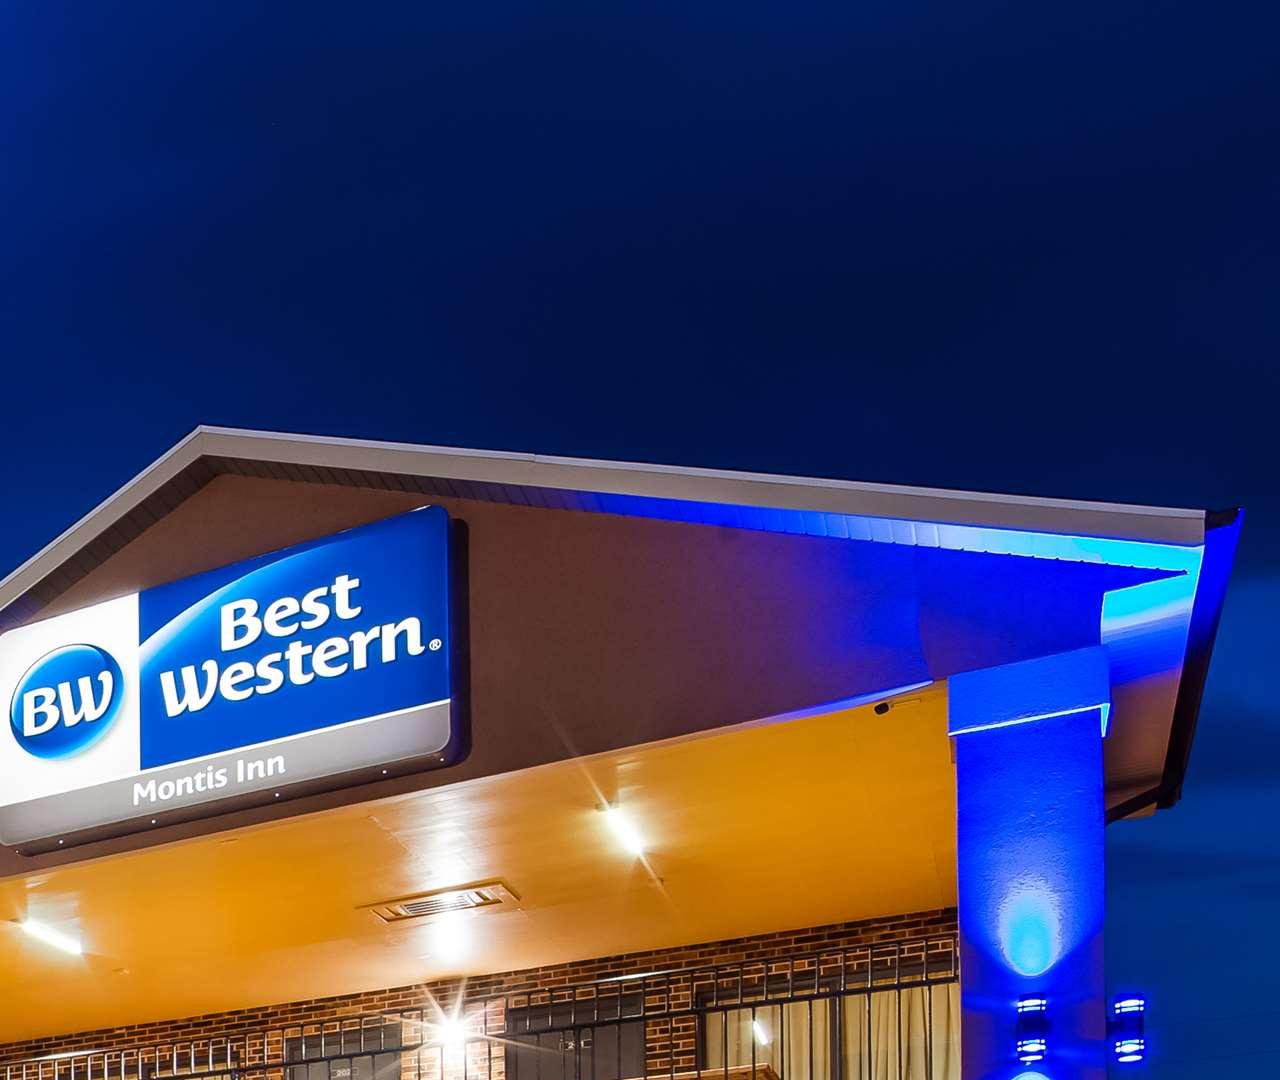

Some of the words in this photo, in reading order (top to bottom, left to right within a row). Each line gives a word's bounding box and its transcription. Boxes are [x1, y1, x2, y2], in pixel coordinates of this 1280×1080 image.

[220, 574, 362, 652] Best
[23, 670, 114, 737] BW
[133, 765, 228, 806] Montis
[237, 755, 286, 783] Inn
